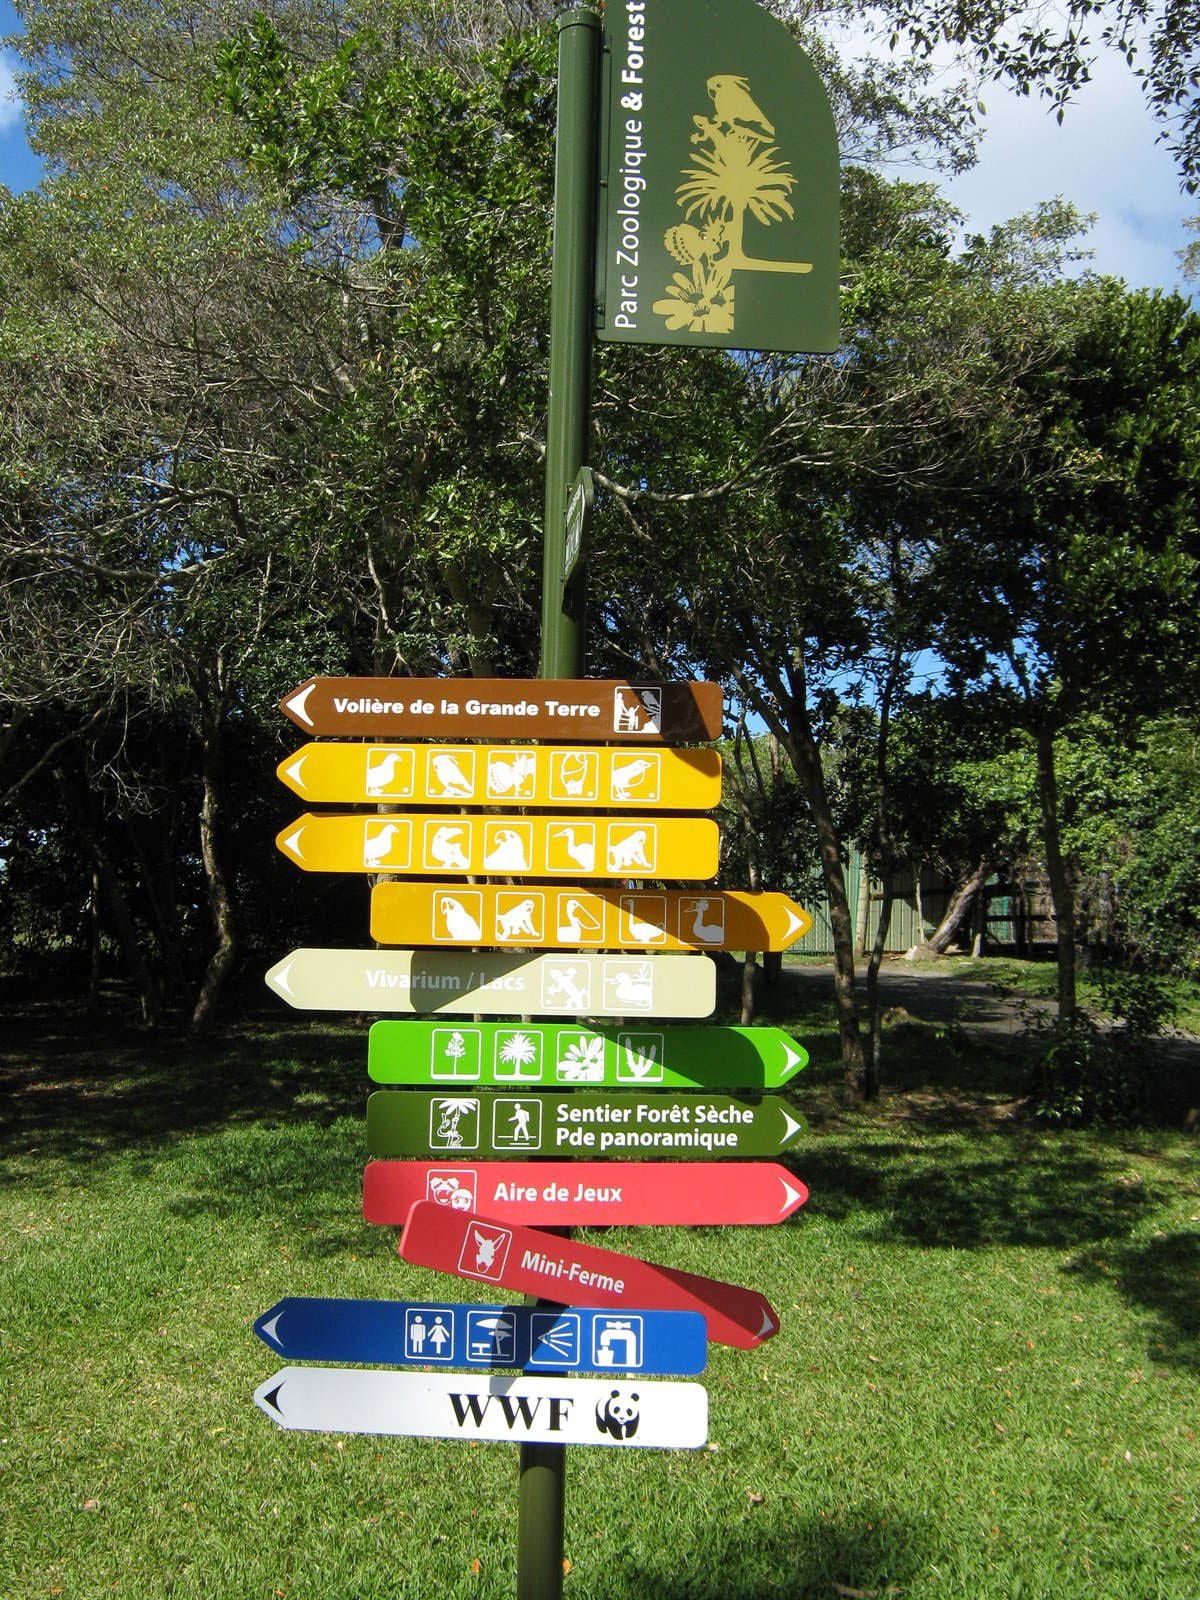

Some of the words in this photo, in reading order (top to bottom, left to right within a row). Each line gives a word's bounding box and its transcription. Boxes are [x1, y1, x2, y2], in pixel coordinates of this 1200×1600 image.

[621, 0, 646, 84] Forest
[620, 92, 643, 111] &
[616, 118, 647, 266] Zoologique
[614, 273, 638, 329] Parc
[333, 697, 404, 715] Volière
[409, 699, 435, 715] de
[440, 699, 459, 716] la
[465, 700, 539, 717] Grande
[545, 701, 601, 718] Terre
[366, 969, 460, 991] Vivarium
[466, 971, 476, 991] /
[480, 972, 525, 992] Lacs
[556, 1103, 632, 1123] Sentier
[636, 1104, 690, 1124] Forêt
[695, 1104, 754, 1124] Sèche
[556, 1127, 596, 1147] Pde
[600, 1128, 738, 1151] panoramique
[493, 1183, 538, 1202] Aire
[542, 1182, 568, 1202] de
[574, 1184, 623, 1203] Jeux
[521, 1250, 626, 1295] Mini-Ferme
[447, 1393, 574, 1431] WWF
